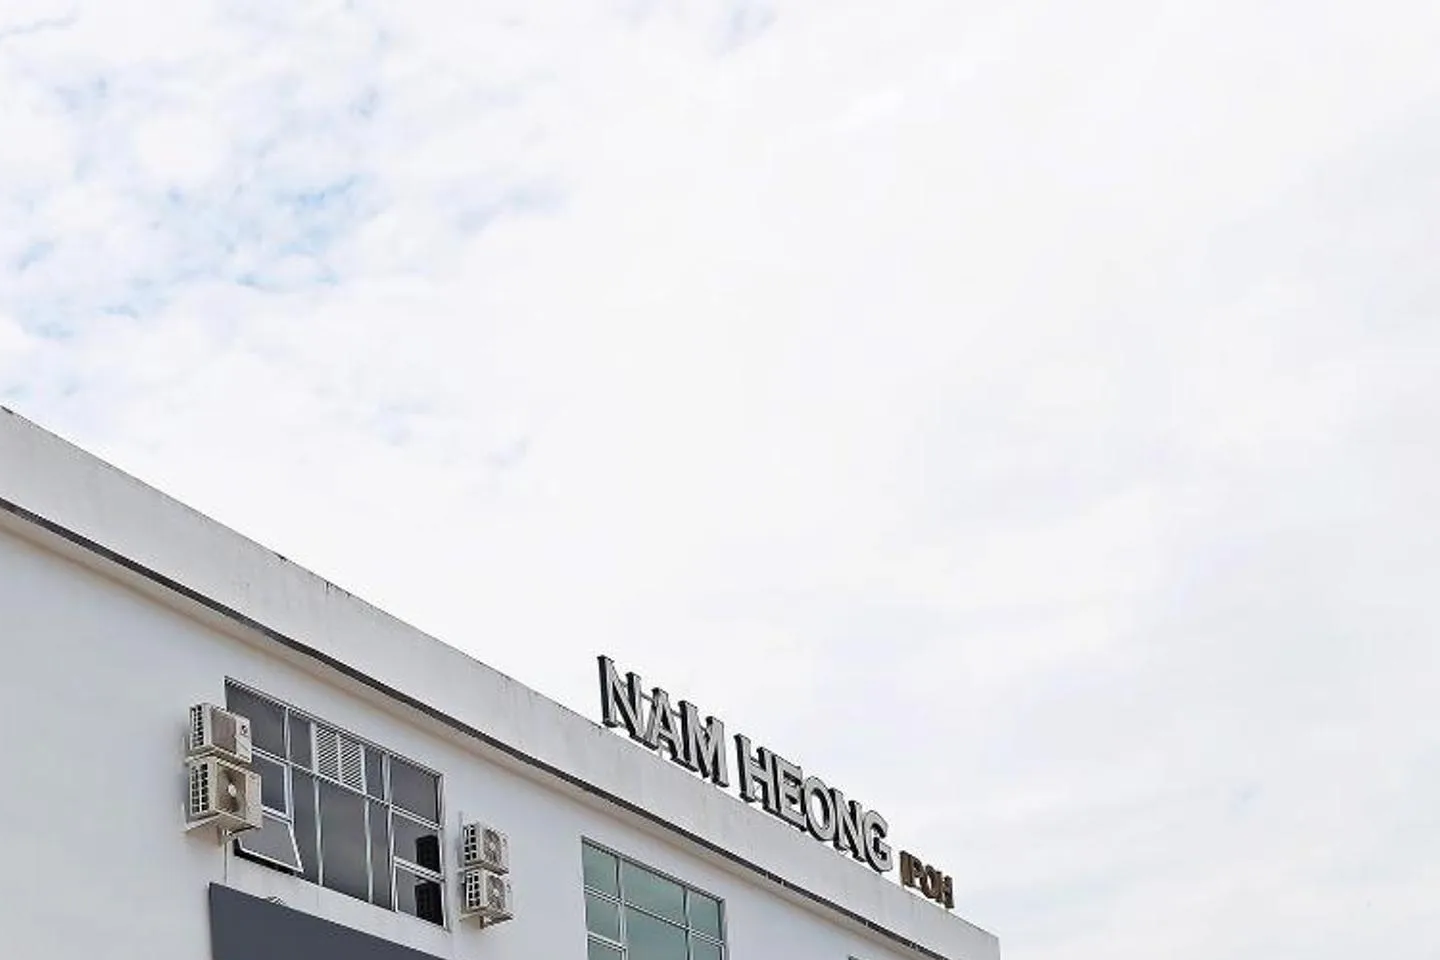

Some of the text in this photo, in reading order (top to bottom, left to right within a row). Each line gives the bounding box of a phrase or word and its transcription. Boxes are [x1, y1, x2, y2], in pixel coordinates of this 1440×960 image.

[597, 654, 955, 909] NAM HEONG IPOH
